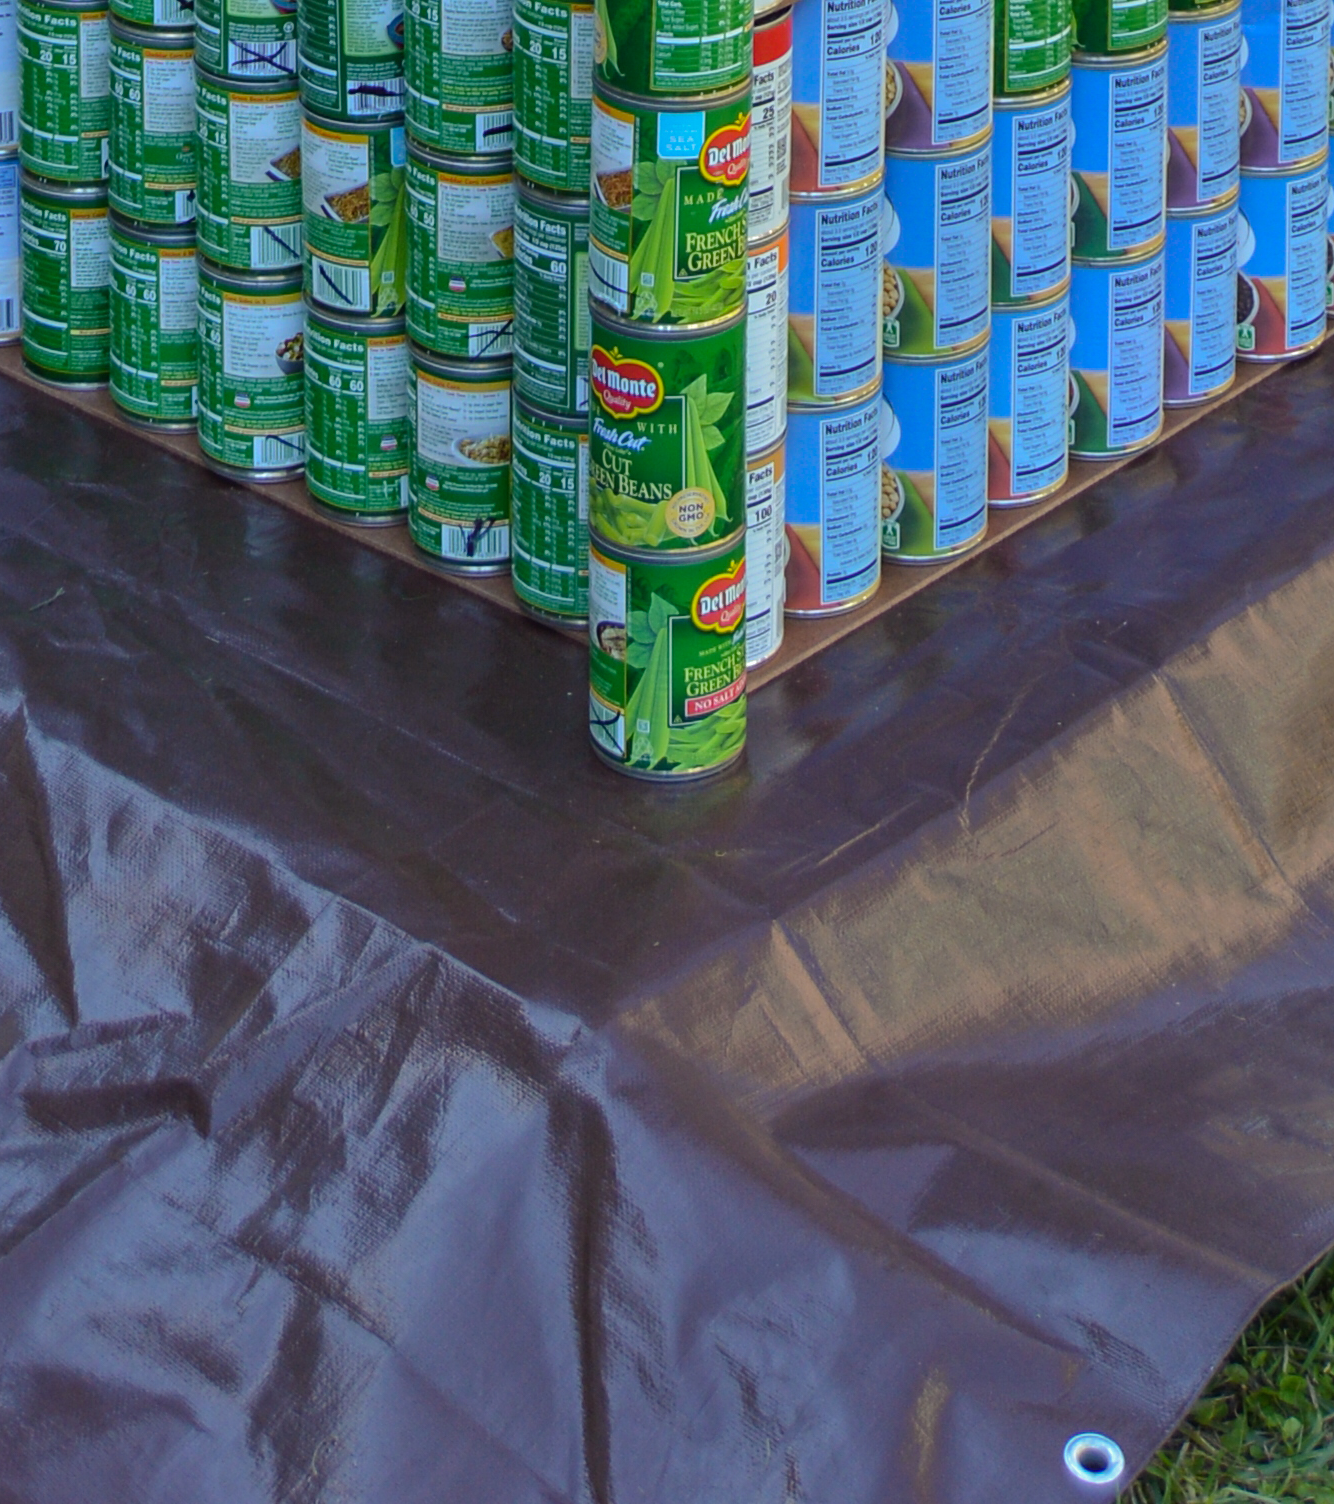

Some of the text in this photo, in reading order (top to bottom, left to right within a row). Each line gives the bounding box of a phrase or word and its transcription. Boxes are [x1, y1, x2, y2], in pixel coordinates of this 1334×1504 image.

[607, 370, 657, 399] Monte
[694, 689, 735, 712] NO SALT
